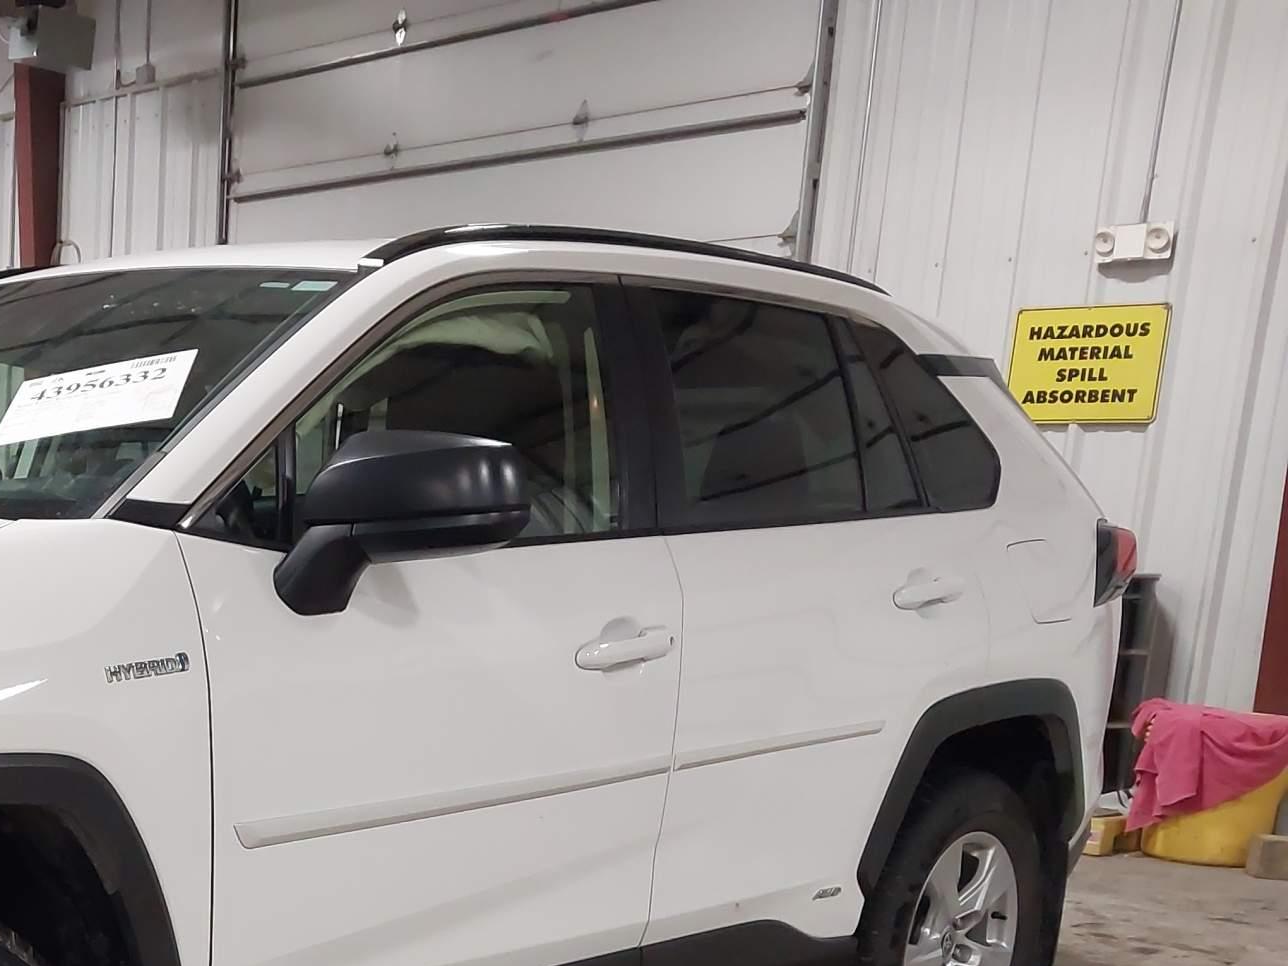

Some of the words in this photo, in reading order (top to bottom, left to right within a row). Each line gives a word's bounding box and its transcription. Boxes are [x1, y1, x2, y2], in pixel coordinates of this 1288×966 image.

[1029, 323, 1151, 340] HAZARDOUS
[1037, 345, 1133, 361] MATERIAL
[1056, 368, 1108, 382] SPILL
[31, 368, 167, 401] 43956332
[1022, 389, 1138, 404] ABSORBENT
[104, 657, 179, 683] HYBRID
